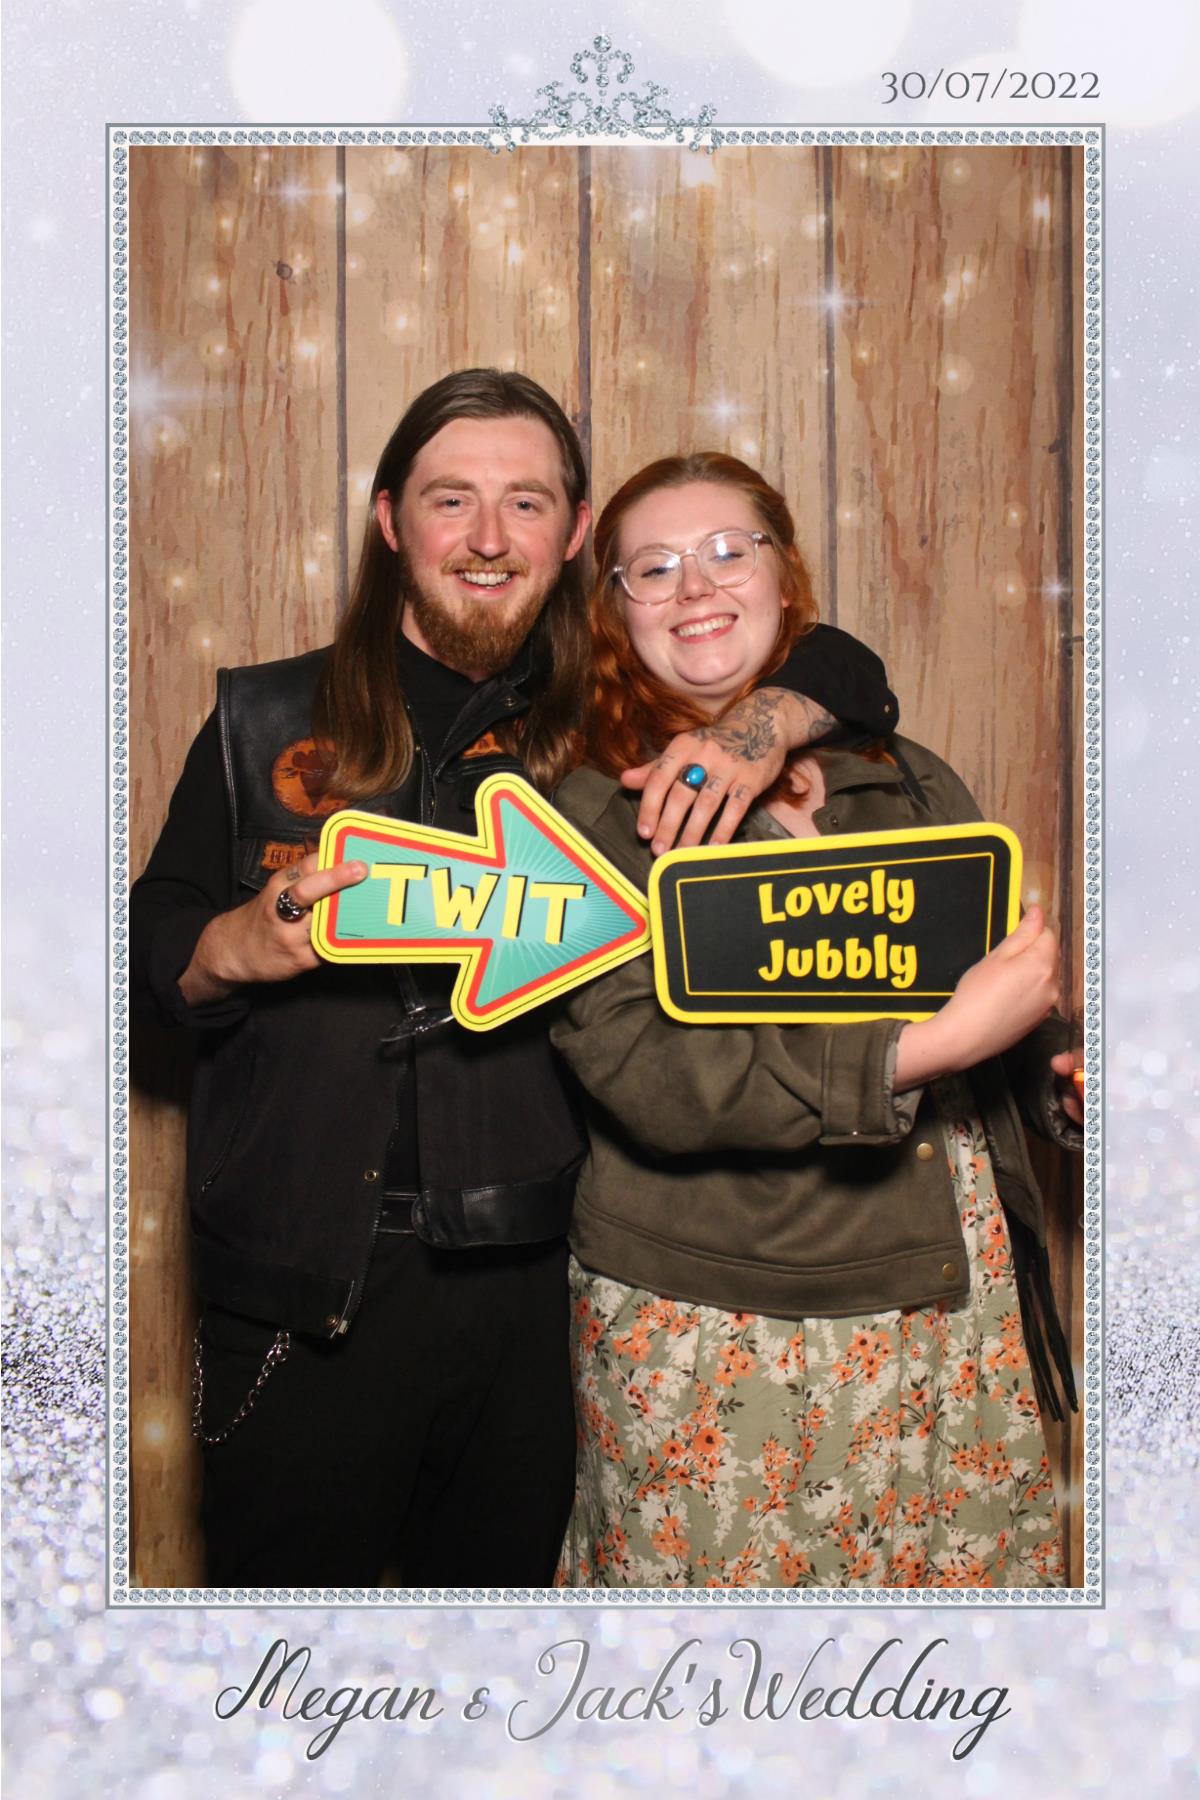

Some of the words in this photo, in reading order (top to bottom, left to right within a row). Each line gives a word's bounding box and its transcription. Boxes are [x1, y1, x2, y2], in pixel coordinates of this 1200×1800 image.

[370, 861, 588, 946] TWIT
[758, 869, 916, 924] Lovely
[757, 934, 918, 989] Jubbly
